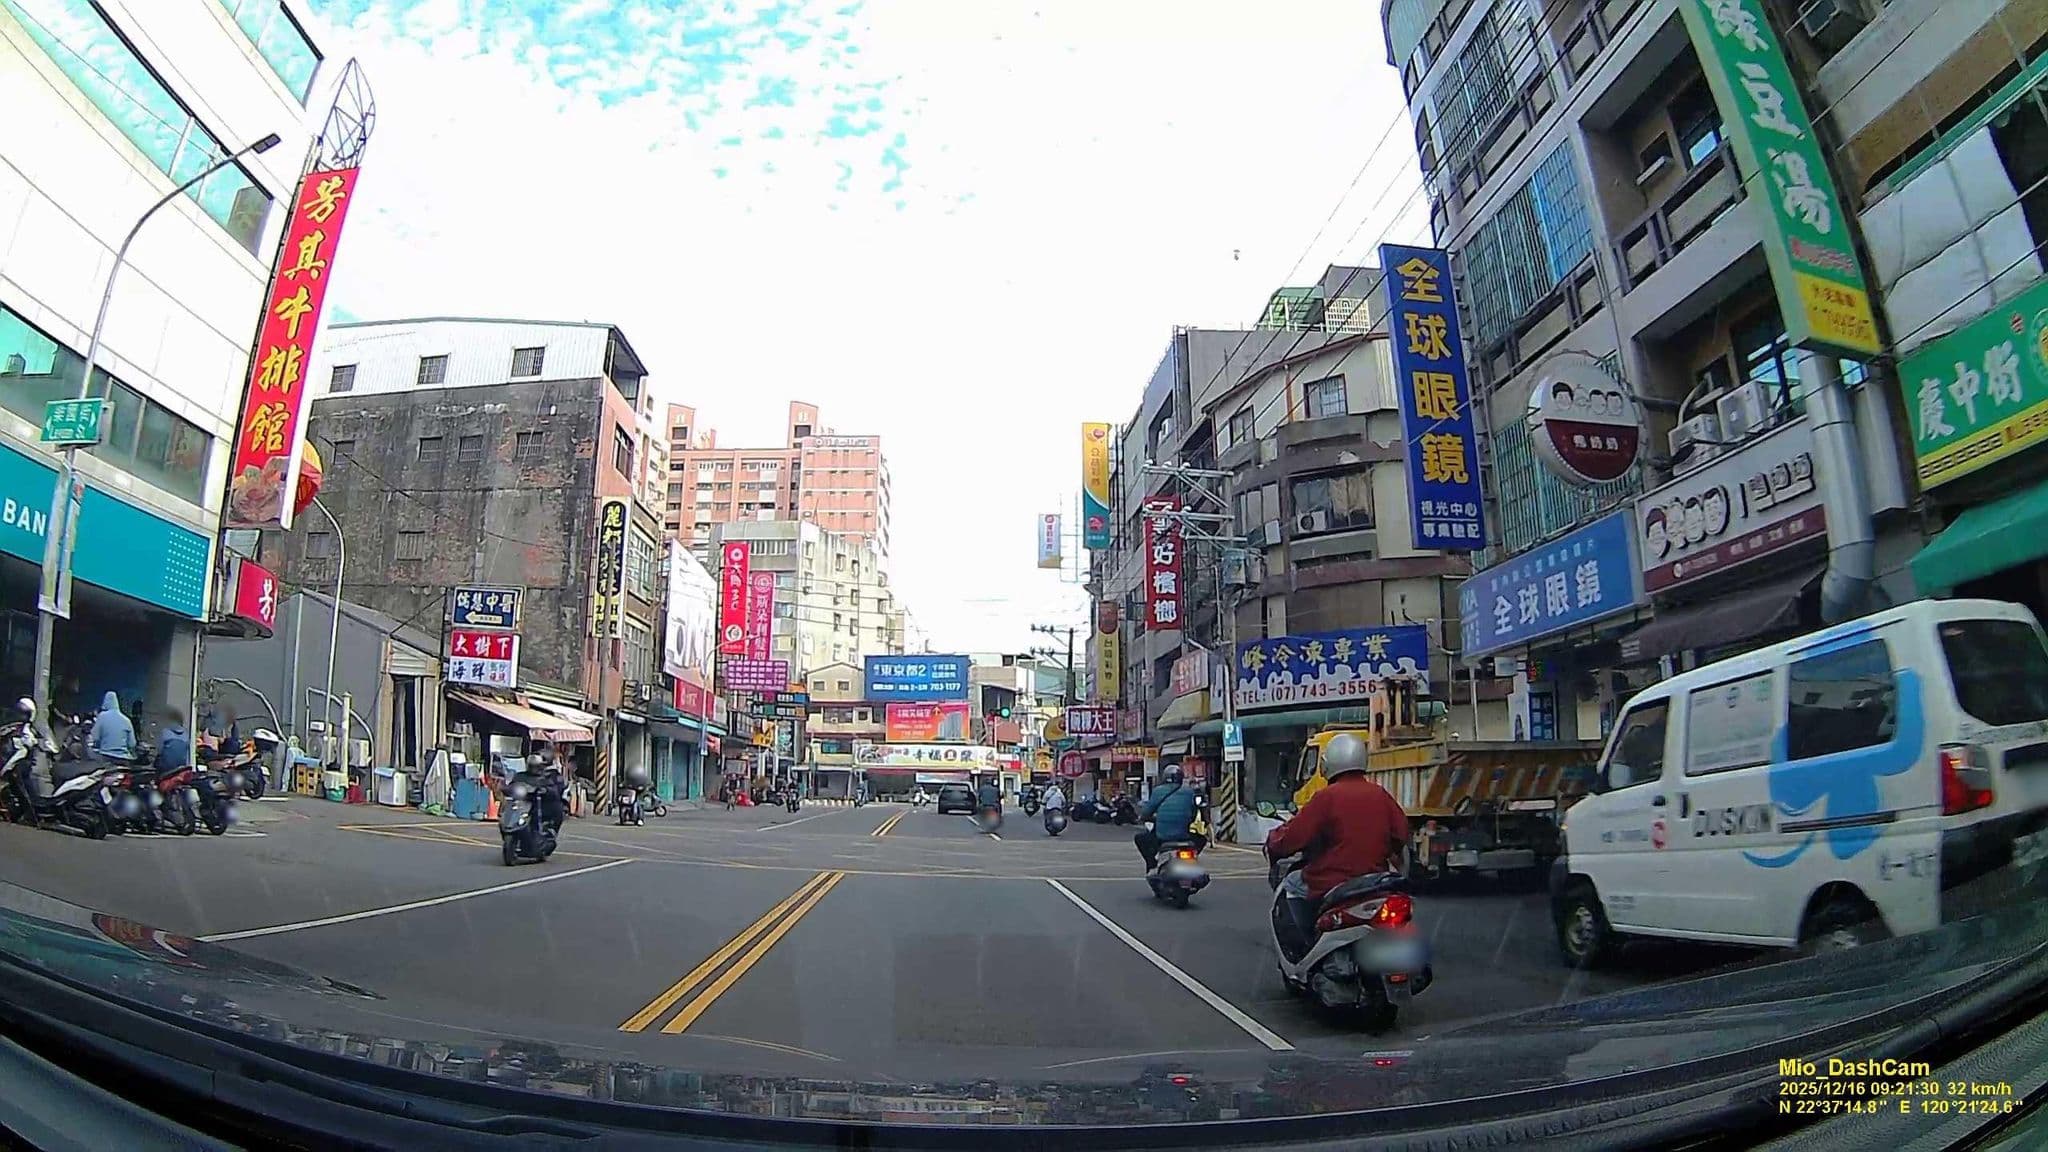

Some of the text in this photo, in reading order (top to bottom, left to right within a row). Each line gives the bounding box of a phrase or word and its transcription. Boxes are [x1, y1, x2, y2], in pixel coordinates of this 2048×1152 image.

[246, 175, 347, 453] 芳其牛排館
[1396, 257, 1469, 485] 全球眼鏡
[1917, 340, 2023, 441] 慶中街
[1421, 500, 1477, 518] 視光中心
[1493, 559, 1602, 636] 全球眼鏡
[454, 633, 511, 658] 大樹下
[452, 661, 485, 682] 海鮮
[1271, 686, 1297, 702] (07)
